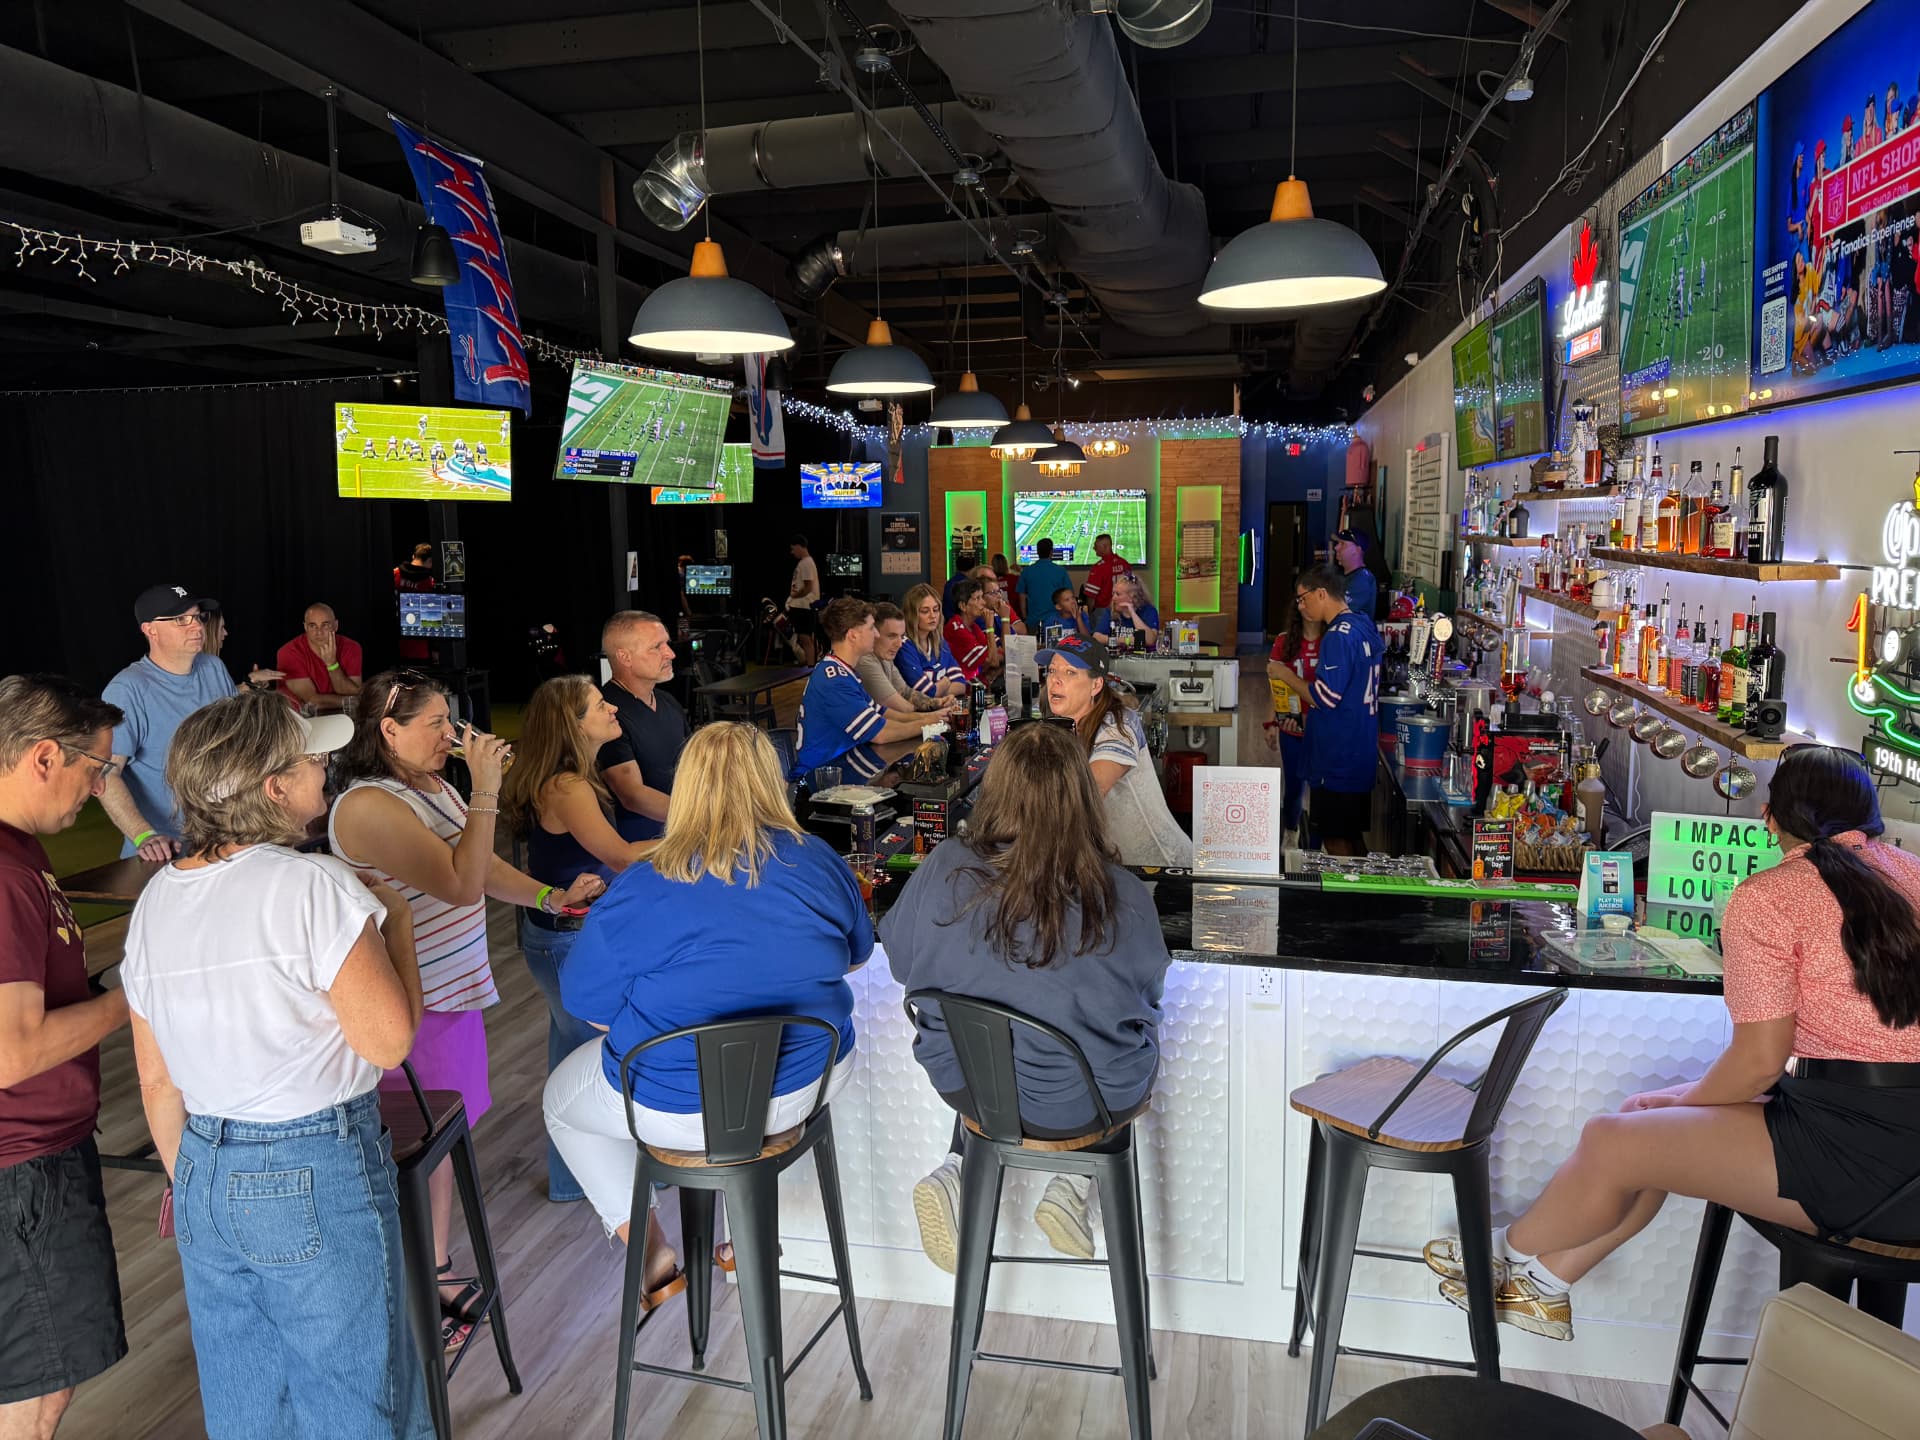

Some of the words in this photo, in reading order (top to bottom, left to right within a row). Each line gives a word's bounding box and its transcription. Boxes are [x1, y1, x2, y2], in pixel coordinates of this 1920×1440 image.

[1851, 161, 1878, 195] NFL
[1840, 232, 1869, 259] Fanatics
[1870, 213, 1916, 243] Experience
[1875, 746, 1903, 775] 19th
[1692, 849, 1759, 876] GOLF
